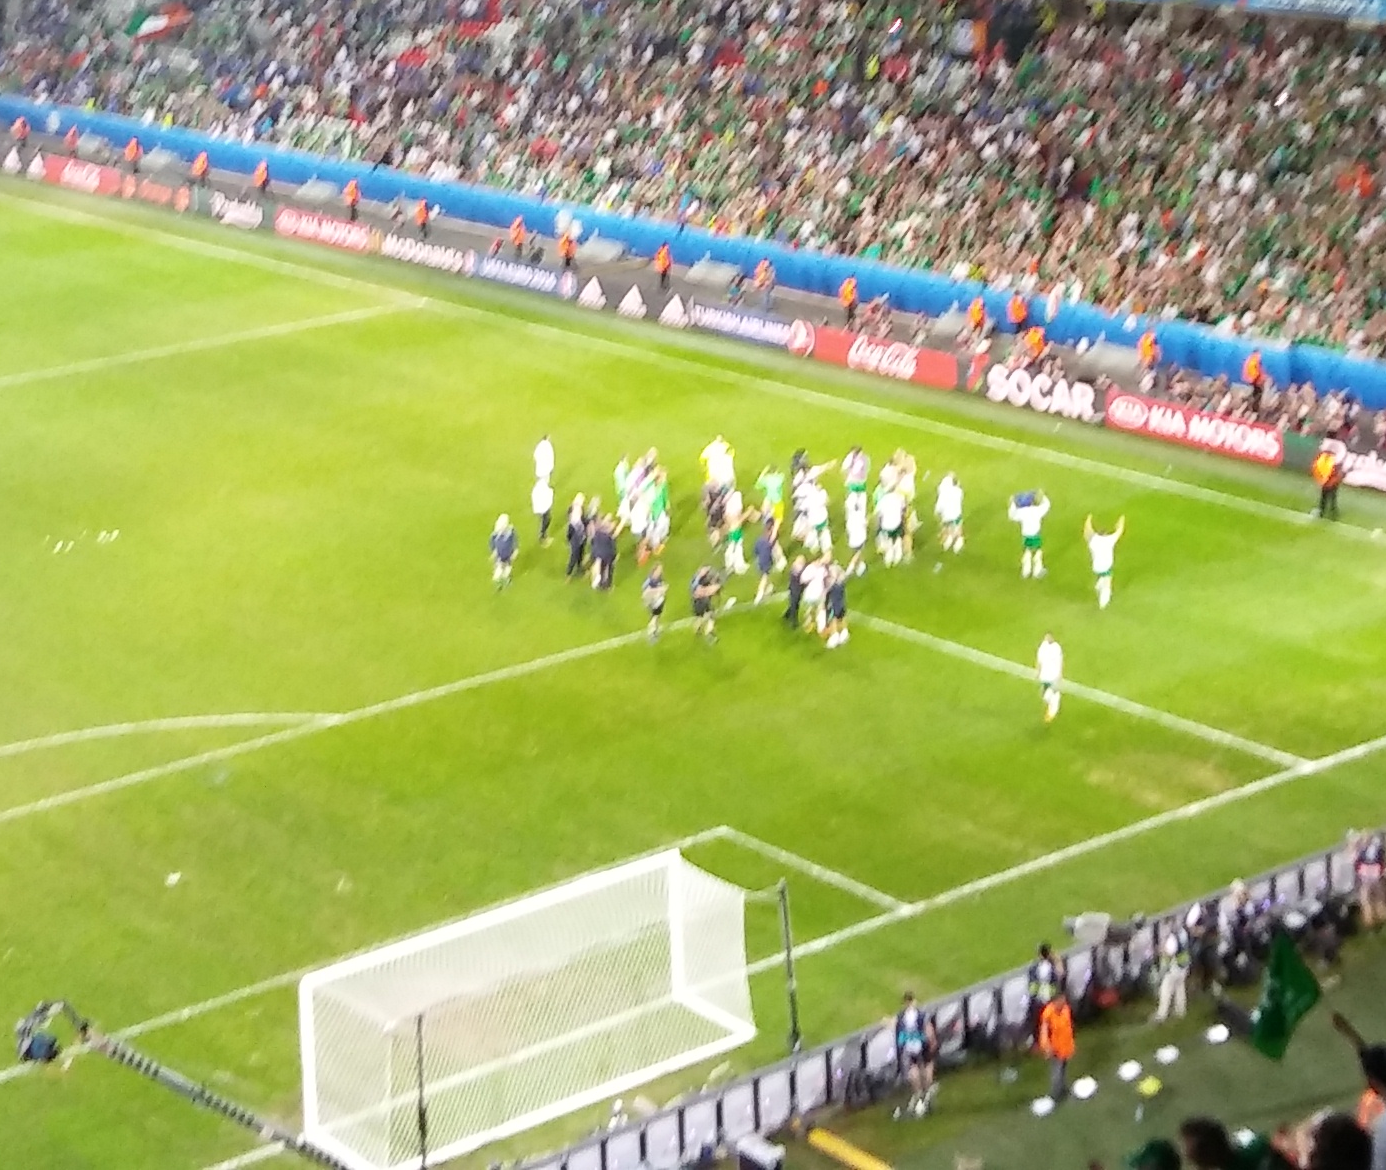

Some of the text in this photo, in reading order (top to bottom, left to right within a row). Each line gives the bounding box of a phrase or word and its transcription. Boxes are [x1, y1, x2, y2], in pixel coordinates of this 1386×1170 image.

[986, 363, 1096, 422] SOCAR
[1148, 404, 1186, 438] KIA
[1187, 414, 1281, 460] MOTORS
